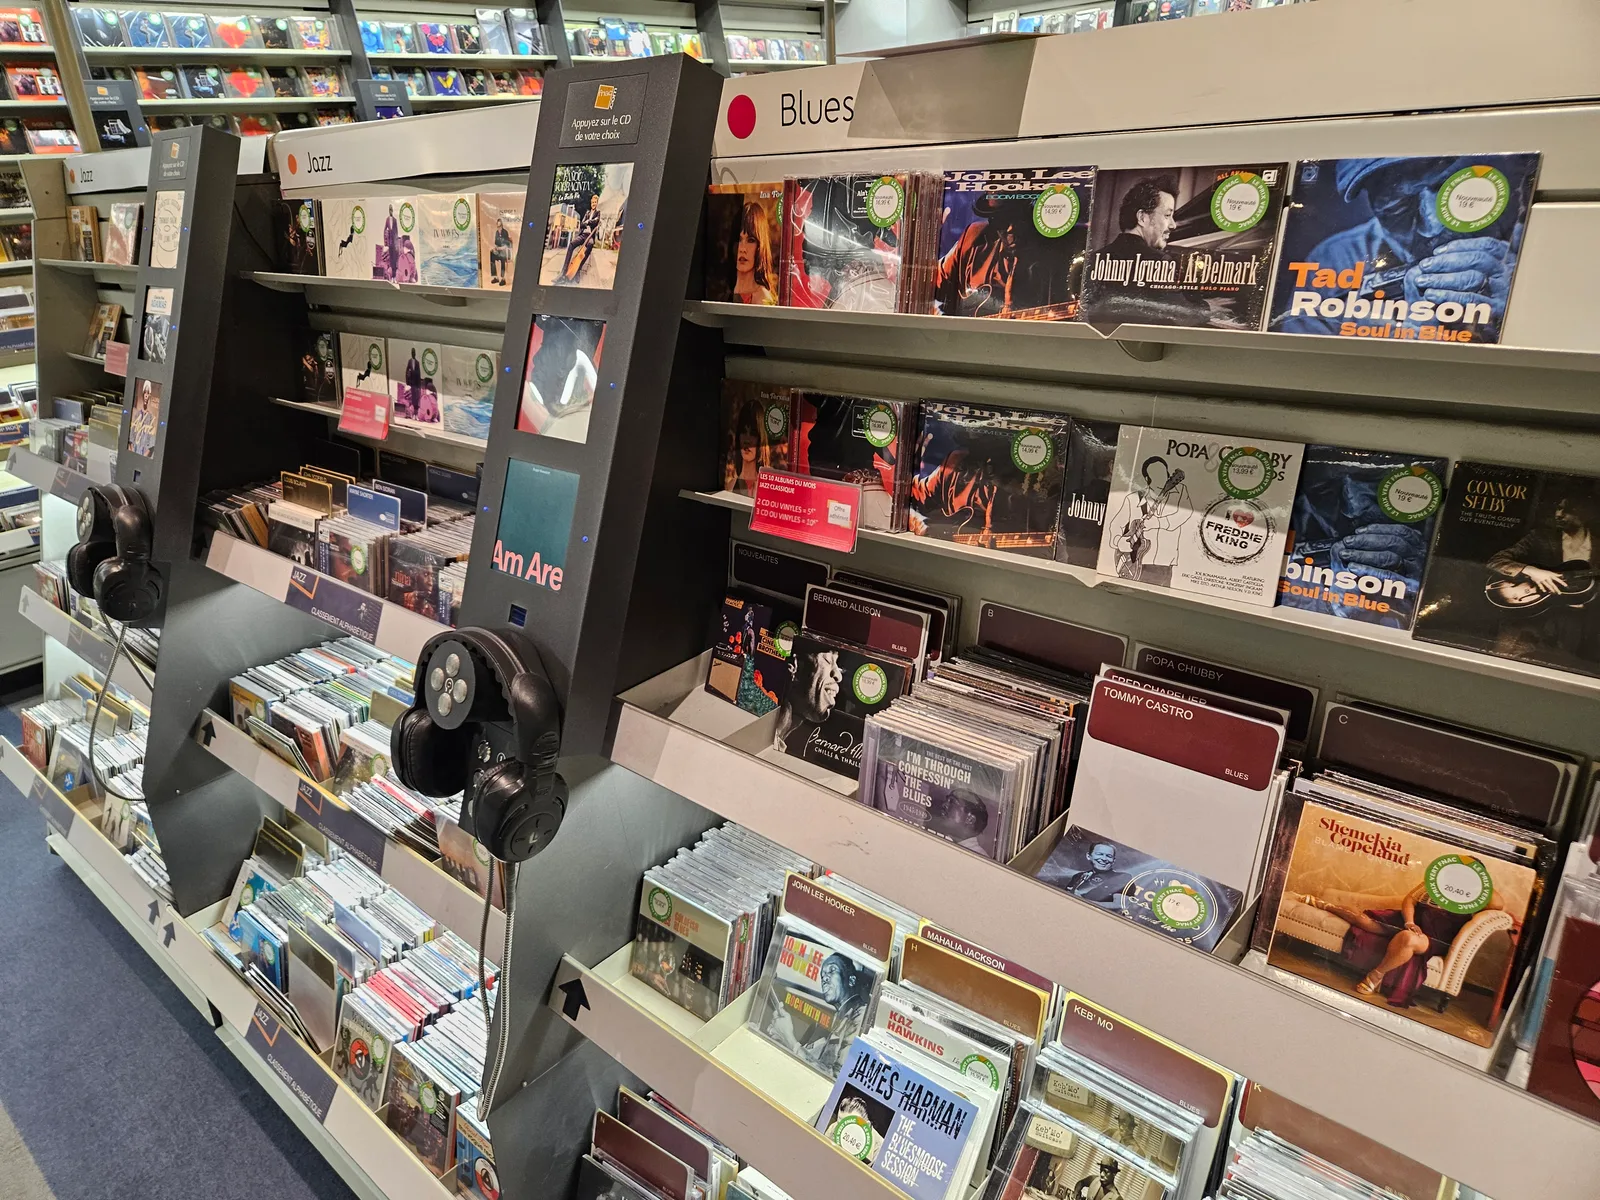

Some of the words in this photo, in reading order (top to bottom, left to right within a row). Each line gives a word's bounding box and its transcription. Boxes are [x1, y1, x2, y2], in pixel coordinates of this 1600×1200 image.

[781, 92, 854, 126] Blues
[571, 118, 600, 130] Appuyez
[600, 118, 611, 126] sur
[612, 115, 618, 126] le
[620, 114, 632, 124] CD
[575, 131, 584, 141] de
[584, 132, 600, 140] votre
[602, 130, 620, 140] choix
[307, 152, 333, 173] Jazz
[80, 167, 93, 183] Jazz
[945, 171, 1025, 182] John
[1032, 170, 1094, 180] Lee
[1090, 253, 1133, 286] Johnny
[1133, 254, 1176, 286] Iguana
[1183, 254, 1199, 284] At
[1201, 254, 1260, 286] Delmark
[1288, 261, 1364, 289] Tad
[1290, 290, 1492, 324] Robinson
[1340, 322, 1390, 338] Soul
[1395, 323, 1416, 339] in
[1418, 326, 1472, 342] Blue
[928, 404, 996, 419] John
[1166, 439, 1210, 460] POPA
[770, 484, 795, 494] CLASSIQUE
[775, 476, 794, 486] ALBUMS
[1466, 480, 1528, 500] CONNOR
[1395, 489, 1428, 500] Nouveauté
[1462, 494, 1507, 513] SELBY
[780, 503, 802, 513] VINYLES
[1068, 493, 1106, 525] Johnny
[1460, 510, 1474, 518] THE
[1475, 512, 1496, 521] TRUTH
[1497, 515, 1521, 524] COMES
[779, 513, 800, 523] VINYLES
[1459, 516, 1472, 524] OUT
[1473, 518, 1514, 529] EVENTUALLY
[1206, 521, 1263, 544] FREDDIE
[1216, 534, 1248, 550] KING
[493, 539, 524, 578] Am
[525, 551, 563, 590] Are
[738, 548, 779, 565] NOUVEAUTES
[293, 570, 307, 583] JAZZ
[813, 592, 849, 609] BERNARD
[849, 602, 881, 618] ALLISON
[1278, 581, 1319, 600] Soul
[1323, 588, 1340, 602] in
[1343, 594, 1390, 614] Blue
[311, 607, 340, 625] CLASSEMENT
[987, 609, 994, 618] B
[891, 644, 907, 653] BLUES
[1146, 653, 1176, 670] POPA
[1178, 662, 1224, 682] CHUBBY
[1112, 675, 1140, 688] FRED
[1103, 686, 1143, 706] TOMMY
[1145, 698, 1193, 720] CASTRO
[1339, 714, 1348, 724] C
[898, 760, 954, 790] CONFESSIN'
[907, 750, 921, 766] I'M
[925, 757, 971, 784] THROUGH
[1225, 767, 1249, 781] BLUES
[300, 785, 313, 798] JAZZ
[904, 774, 922, 791] THE
[903, 787, 932, 808] BLUES
[1490, 802, 1519, 816] BLUES
[1318, 817, 1402, 852] Shemekia
[1330, 832, 1410, 866] Copeland
[1438, 857, 1457, 866] FNAC
[1473, 864, 1481, 872] LE
[1429, 866, 1439, 881] VERT
[1480, 872, 1489, 887] PRIX
[792, 880, 810, 894] JOHN
[811, 888, 825, 902] LEE
[825, 894, 855, 917] HOOKER
[1430, 883, 1440, 897] PRIX
[1444, 884, 1464, 895] 20,40
[1478, 890, 1490, 904] VERT
[784, 935, 806, 956] JOHN
[809, 948, 824, 965] LEE
[862, 943, 877, 953] BLUES
[912, 944, 917, 952] H
[927, 931, 963, 953] MAHALIA
[964, 947, 1005, 971] JACKSON
[780, 951, 820, 981] HOOKER
[256, 1008, 270, 1026] JAZZ
[785, 992, 803, 1012] ROCK
[803, 1002, 821, 1021] WITH
[820, 1012, 831, 1028] ME
[1074, 1004, 1096, 1021] KEB'
[1097, 1016, 1114, 1032] MO
[889, 1011, 913, 1030] KAZ
[1003, 1020, 1020, 1031] BLUES
[887, 1020, 944, 1056] HAWKINS
[267, 1054, 294, 1085] CLASSEMENT
[848, 1051, 900, 1100] JAMES
[1253, 1082, 1262, 1093] K
[898, 1080, 968, 1140] HARMAN
[1179, 1099, 1200, 1115] BLUES
[895, 1115, 917, 1138] THE
[888, 1134, 947, 1181] BLUESMOOSE
[881, 1152, 919, 1188] SESSION
